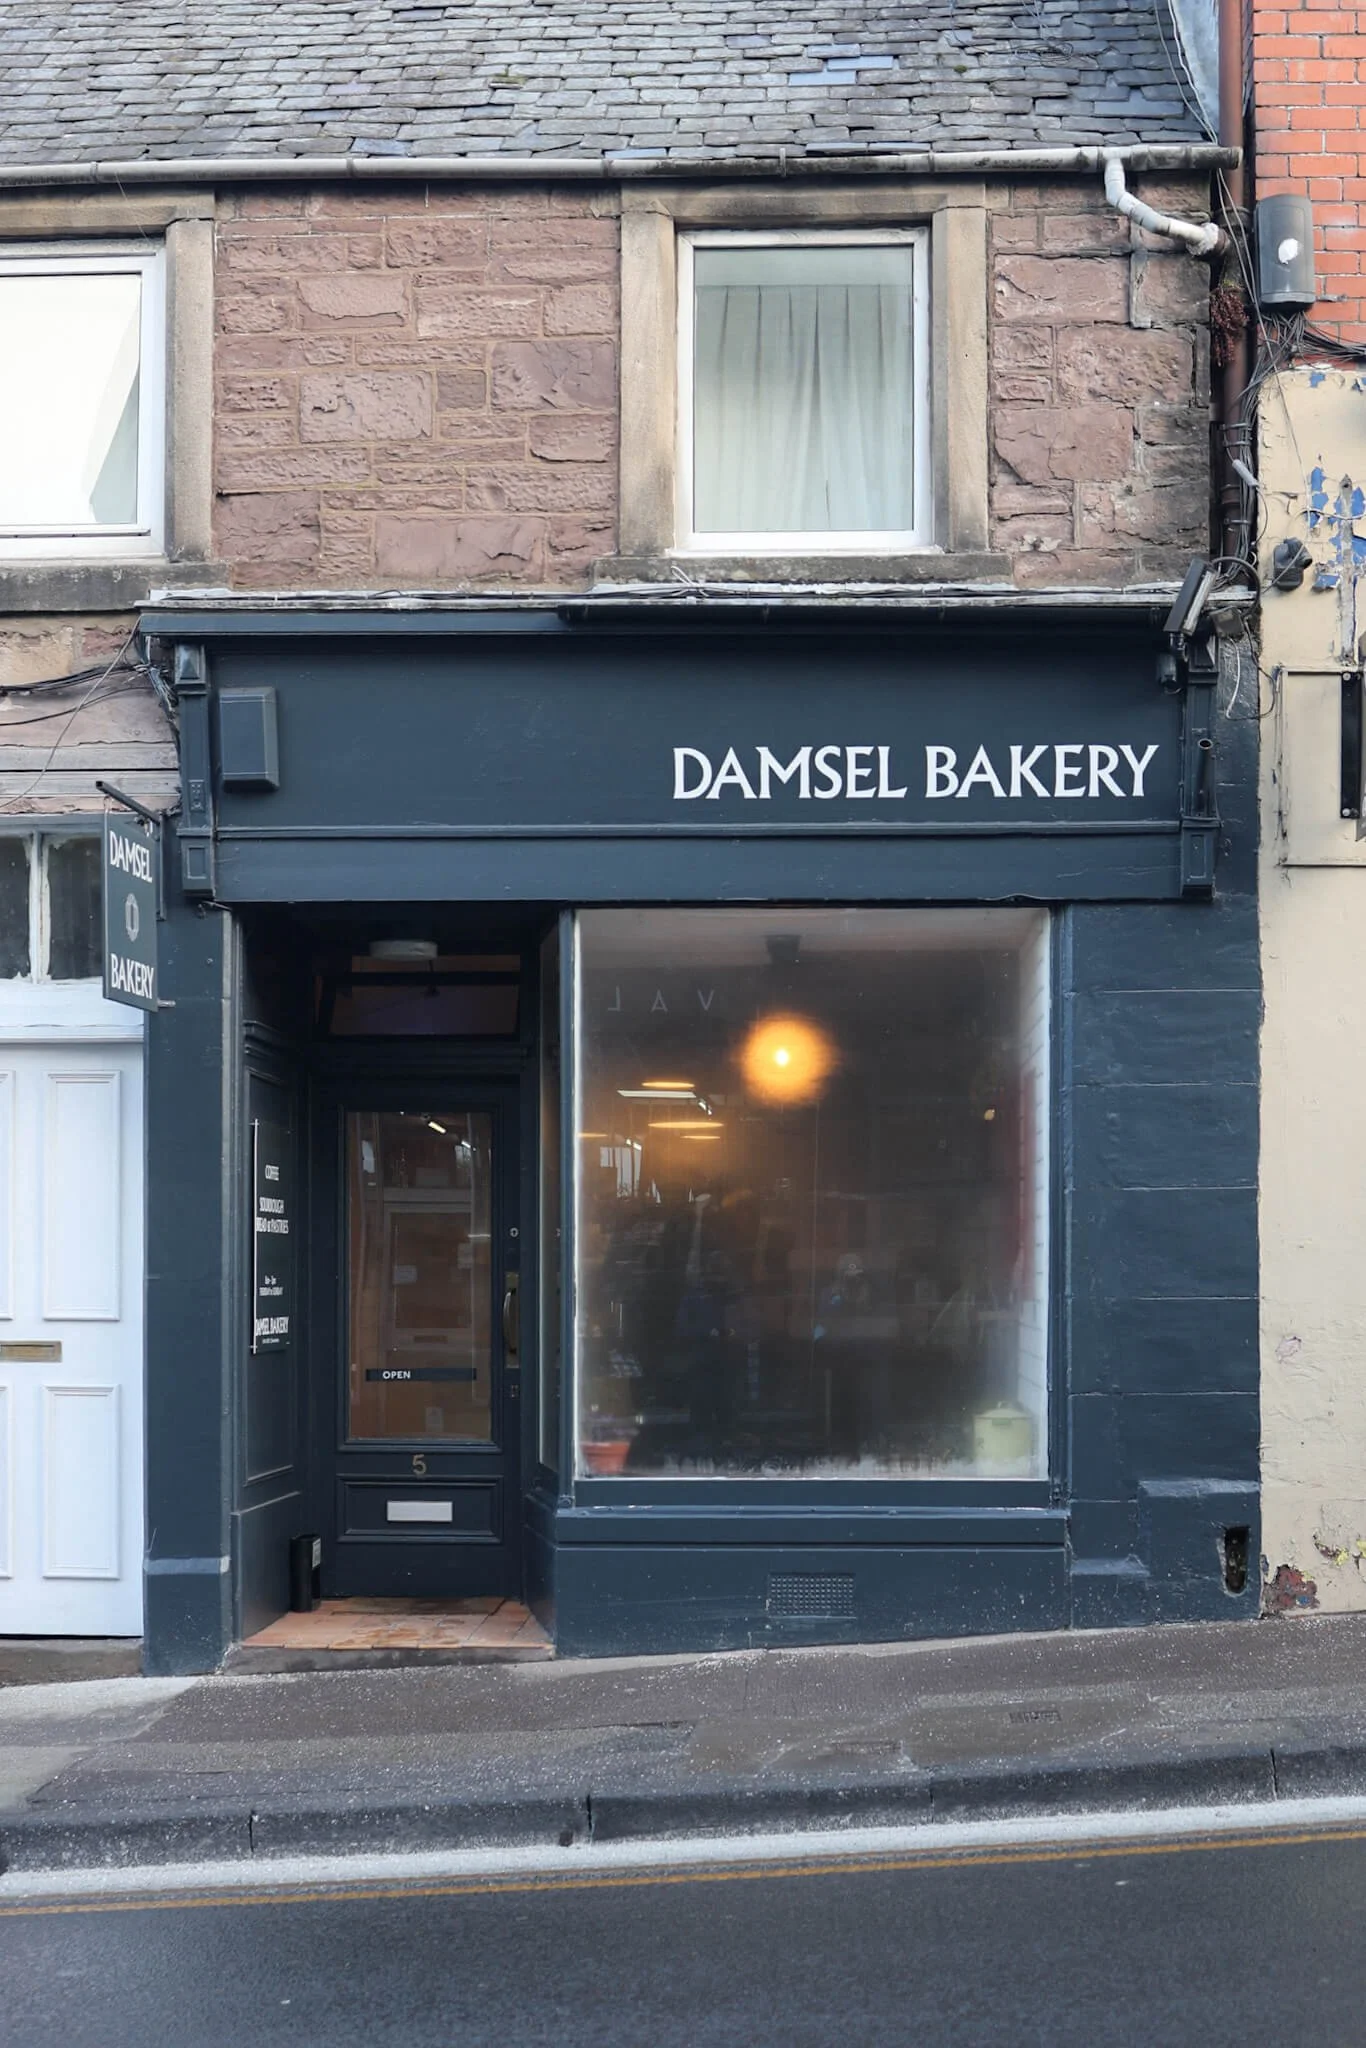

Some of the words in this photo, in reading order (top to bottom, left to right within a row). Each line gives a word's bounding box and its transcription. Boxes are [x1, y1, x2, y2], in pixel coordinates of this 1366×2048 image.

[673, 745, 908, 800] DAMSEL
[925, 744, 1160, 798] BAKERY
[109, 830, 153, 884] DAMSEL
[110, 952, 155, 1000] BAKERY
[382, 1370, 411, 1380] OPEN
[412, 1454, 427, 1476] 5
